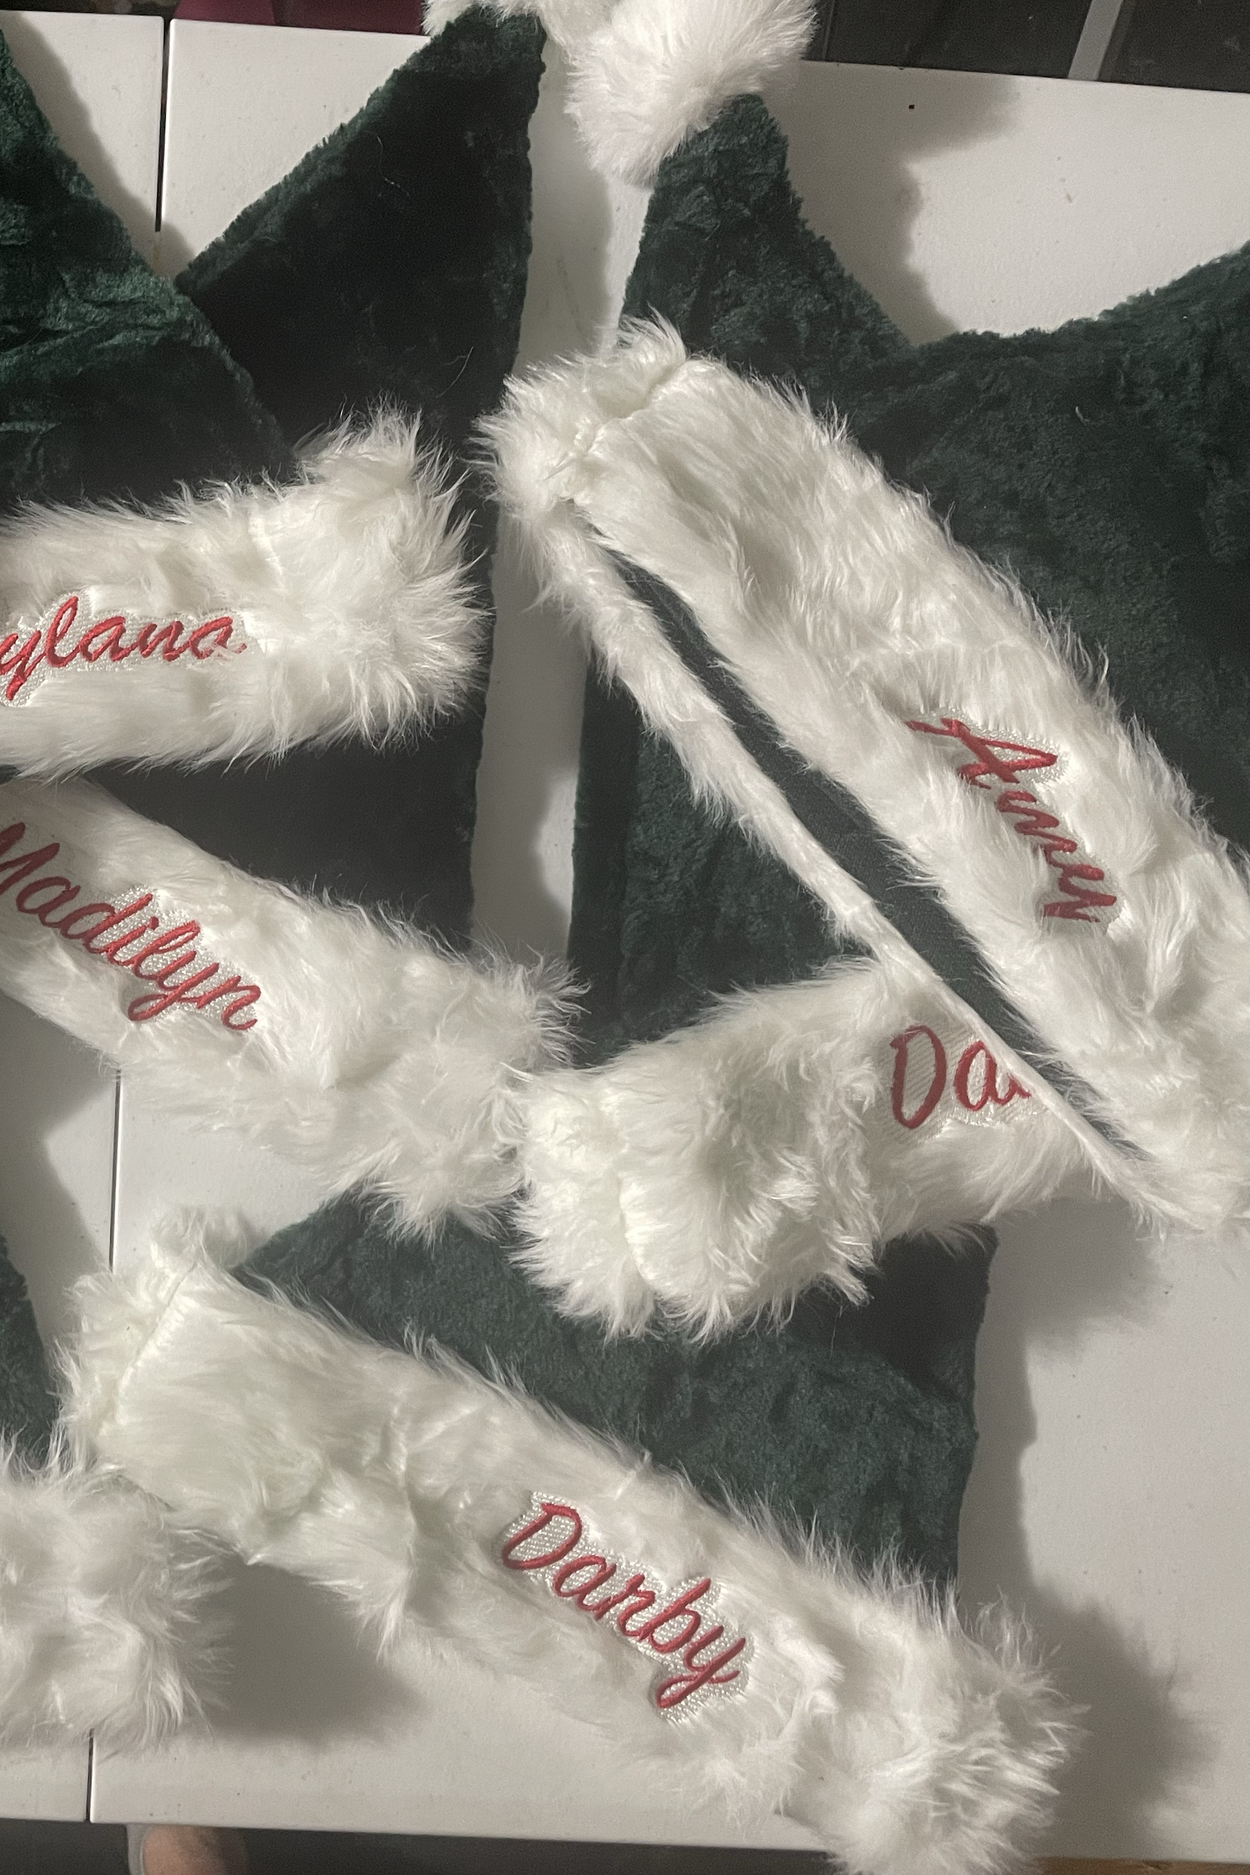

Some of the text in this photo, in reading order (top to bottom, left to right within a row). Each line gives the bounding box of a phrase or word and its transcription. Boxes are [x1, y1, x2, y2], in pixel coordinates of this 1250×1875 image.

[905, 718, 1116, 922] Amy
[889, 1025, 1032, 1129] Da
[502, 1502, 746, 1708] Darby
